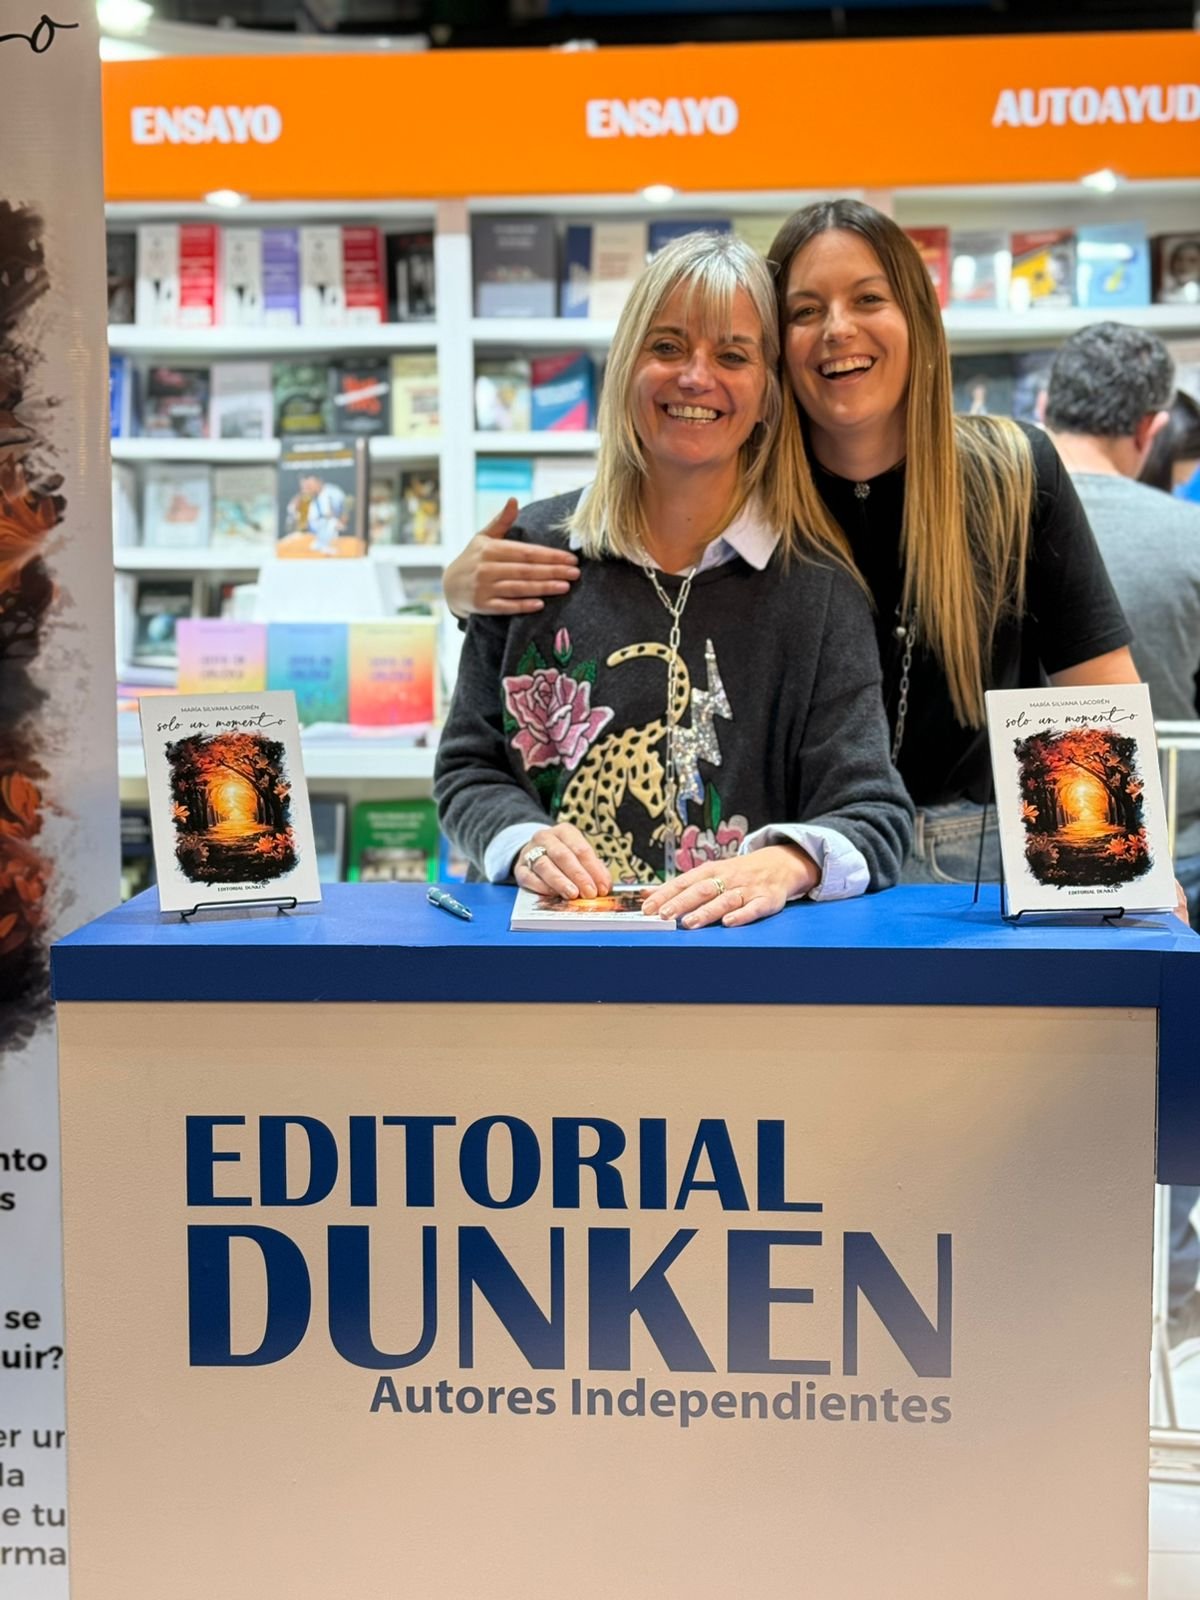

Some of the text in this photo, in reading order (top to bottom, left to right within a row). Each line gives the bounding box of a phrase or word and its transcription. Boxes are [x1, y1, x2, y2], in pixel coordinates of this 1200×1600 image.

[586, 97, 738, 138] ENSAYO
[991, 84, 1200, 128] AUTOAYUD
[131, 105, 281, 144] ENSAYO
[156, 716, 183, 732] solo
[215, 711, 287, 729] momento
[202, 704, 229, 712] SILVANA
[1005, 711, 1032, 728] solo
[1064, 706, 1138, 724] momento
[185, 1114, 823, 1213] EDITORIAL
[187, 1225, 953, 1379] DUNKEN
[4, 1310, 42, 1330] se
[2, 1342, 64, 1370] uir?
[370, 1376, 953, 1427] Autores Independientes
[2, 1503, 65, 1527] e tu
[1, 1547, 66, 1566] rma
